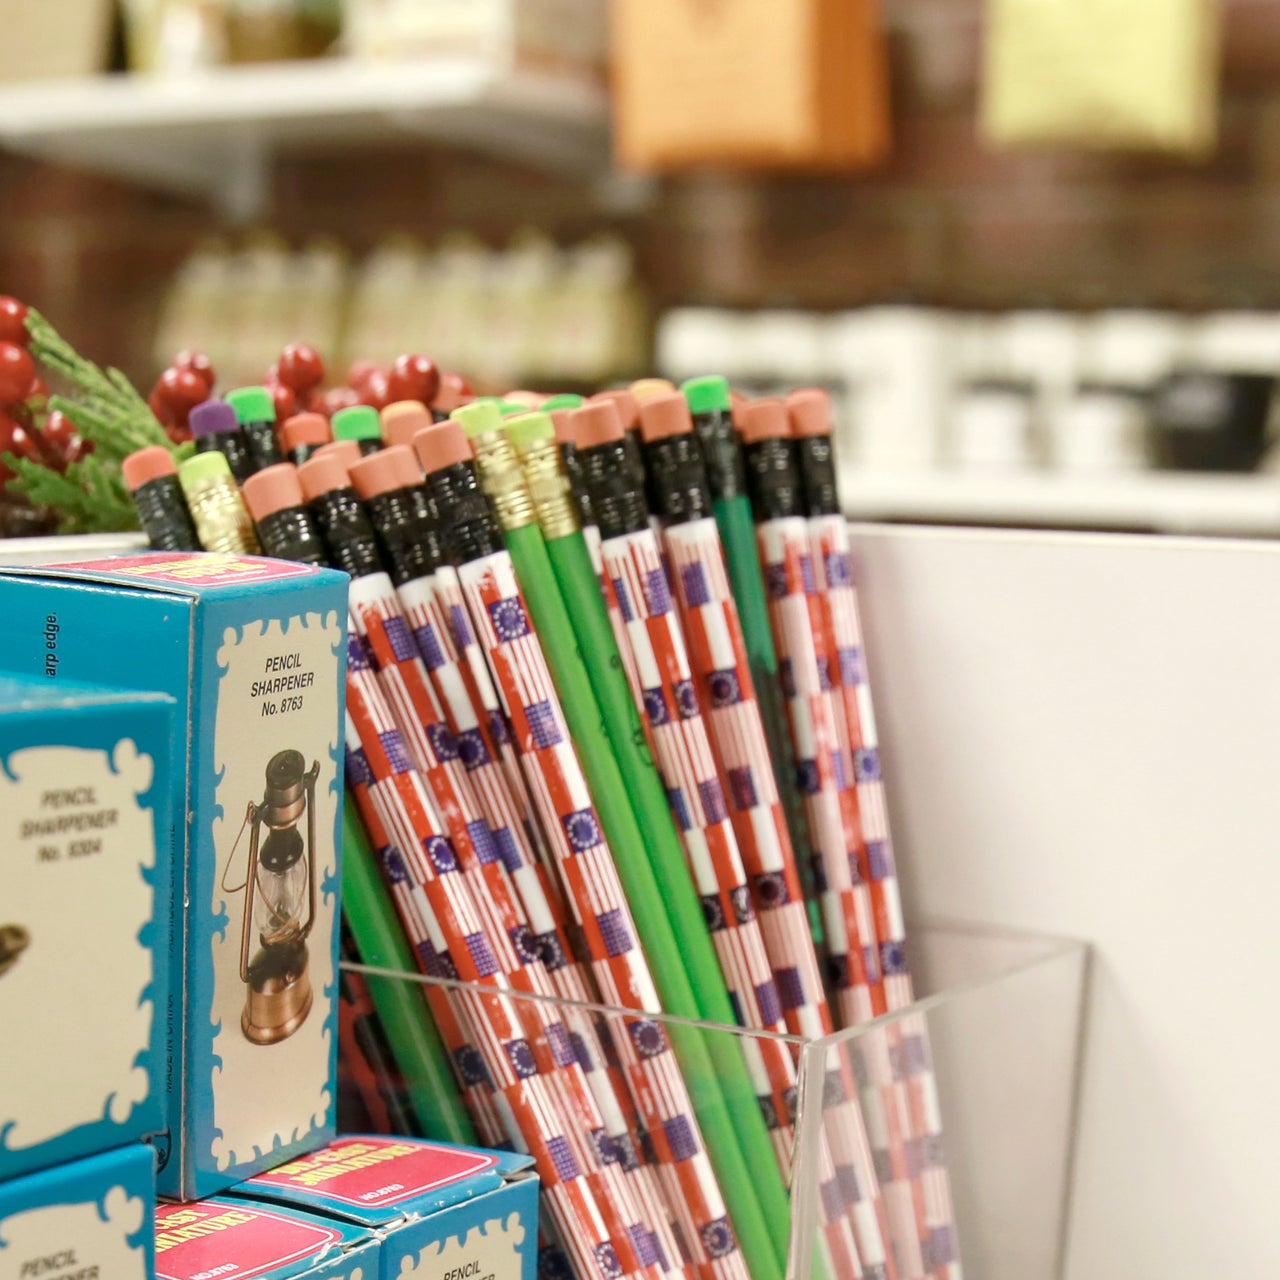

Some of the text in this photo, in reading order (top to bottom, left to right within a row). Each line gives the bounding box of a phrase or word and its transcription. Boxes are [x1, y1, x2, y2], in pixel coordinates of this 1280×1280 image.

[44, 611, 61, 678] arp edge.
[265, 653, 302, 673] PENCIL
[250, 672, 315, 697] SHARPENER
[261, 696, 303, 717] No. 8763
[40, 787, 97, 808] PENCIL
[21, 808, 119, 840] SHARPENER
[268, 1143, 377, 1175] DIE-CAST
[290, 1144, 422, 1186] MINIATURE
[155, 1209, 208, 1230] CAST
[21, 1249, 77, 1279] PENCIL
